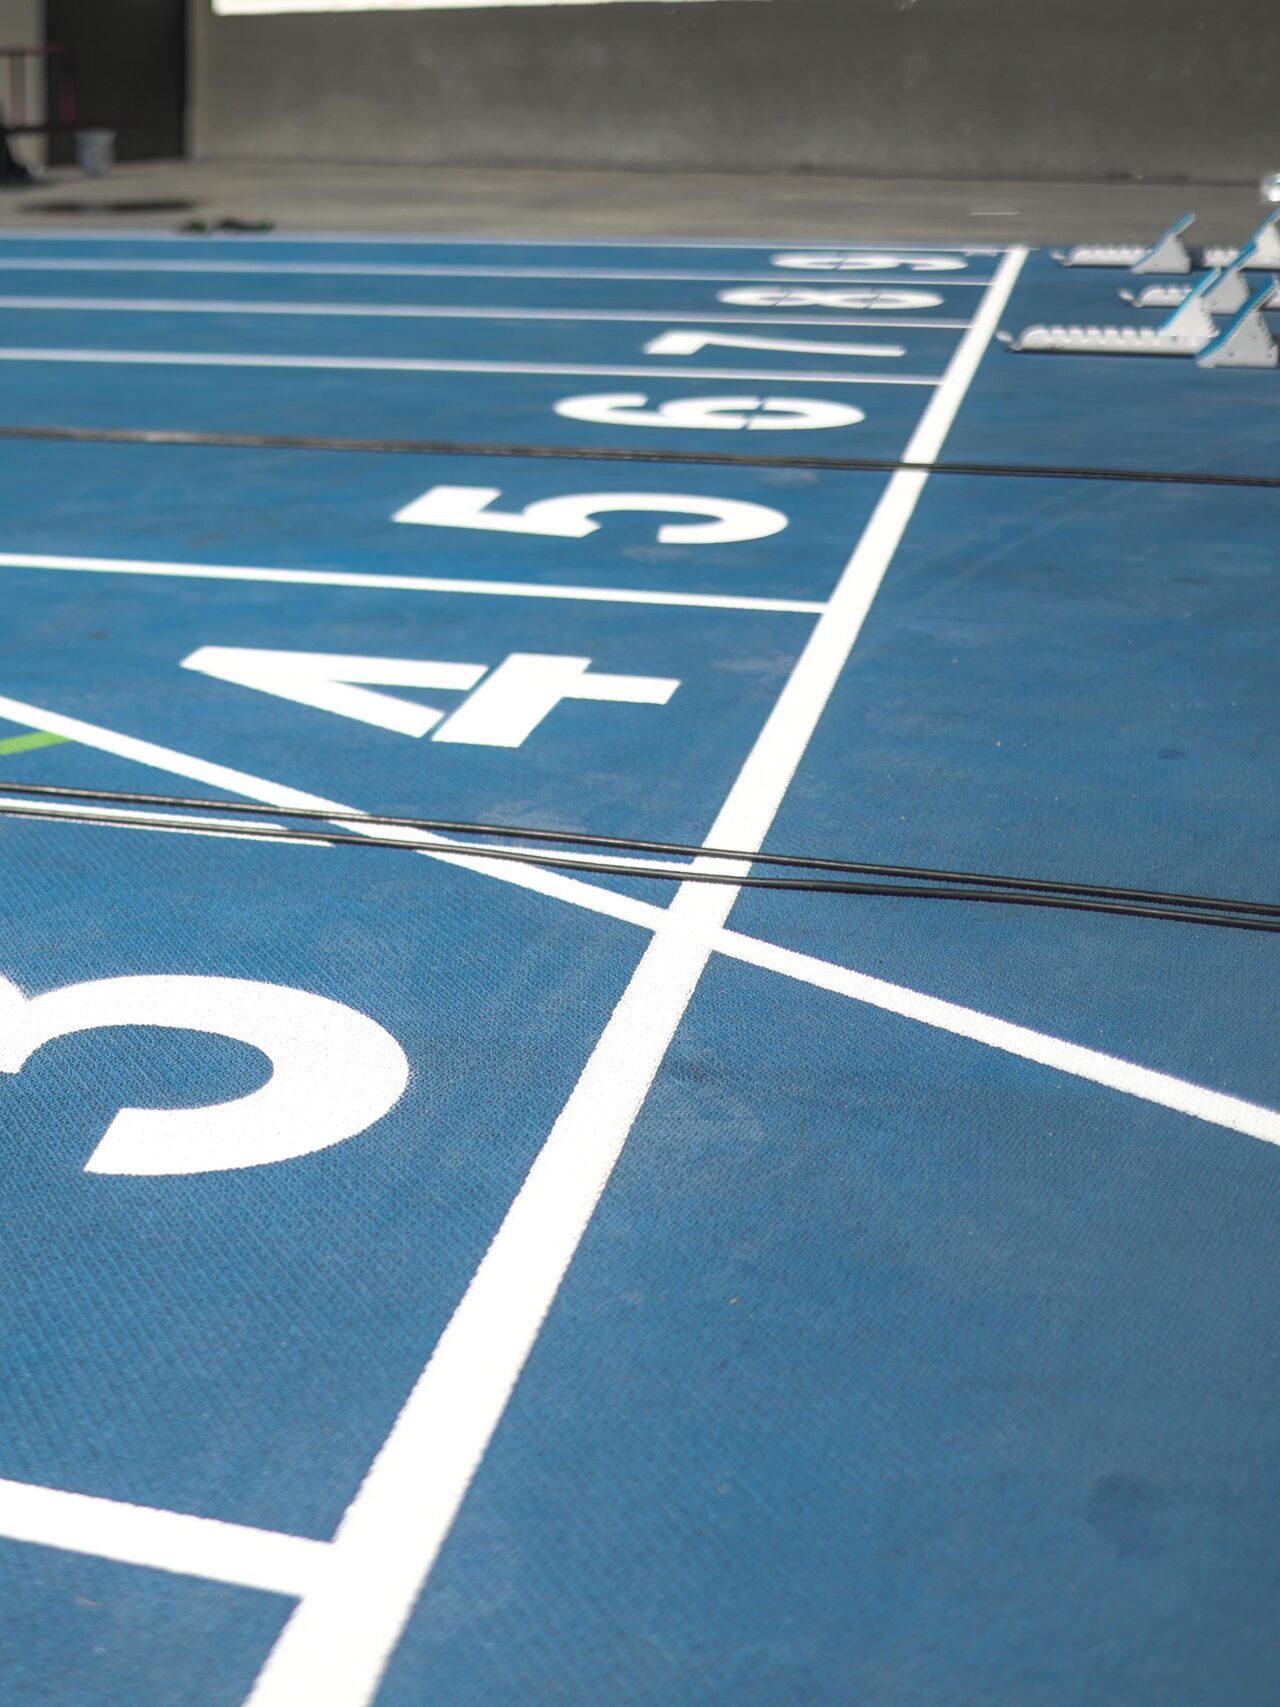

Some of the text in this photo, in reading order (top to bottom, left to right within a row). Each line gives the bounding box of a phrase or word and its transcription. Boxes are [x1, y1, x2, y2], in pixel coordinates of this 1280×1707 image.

[770, 252, 969, 271] 9
[717, 286, 945, 309] 8
[643, 330, 907, 357] 7
[553, 392, 866, 431] 6
[391, 485, 789, 545] 5
[179, 645, 682, 749] 4
